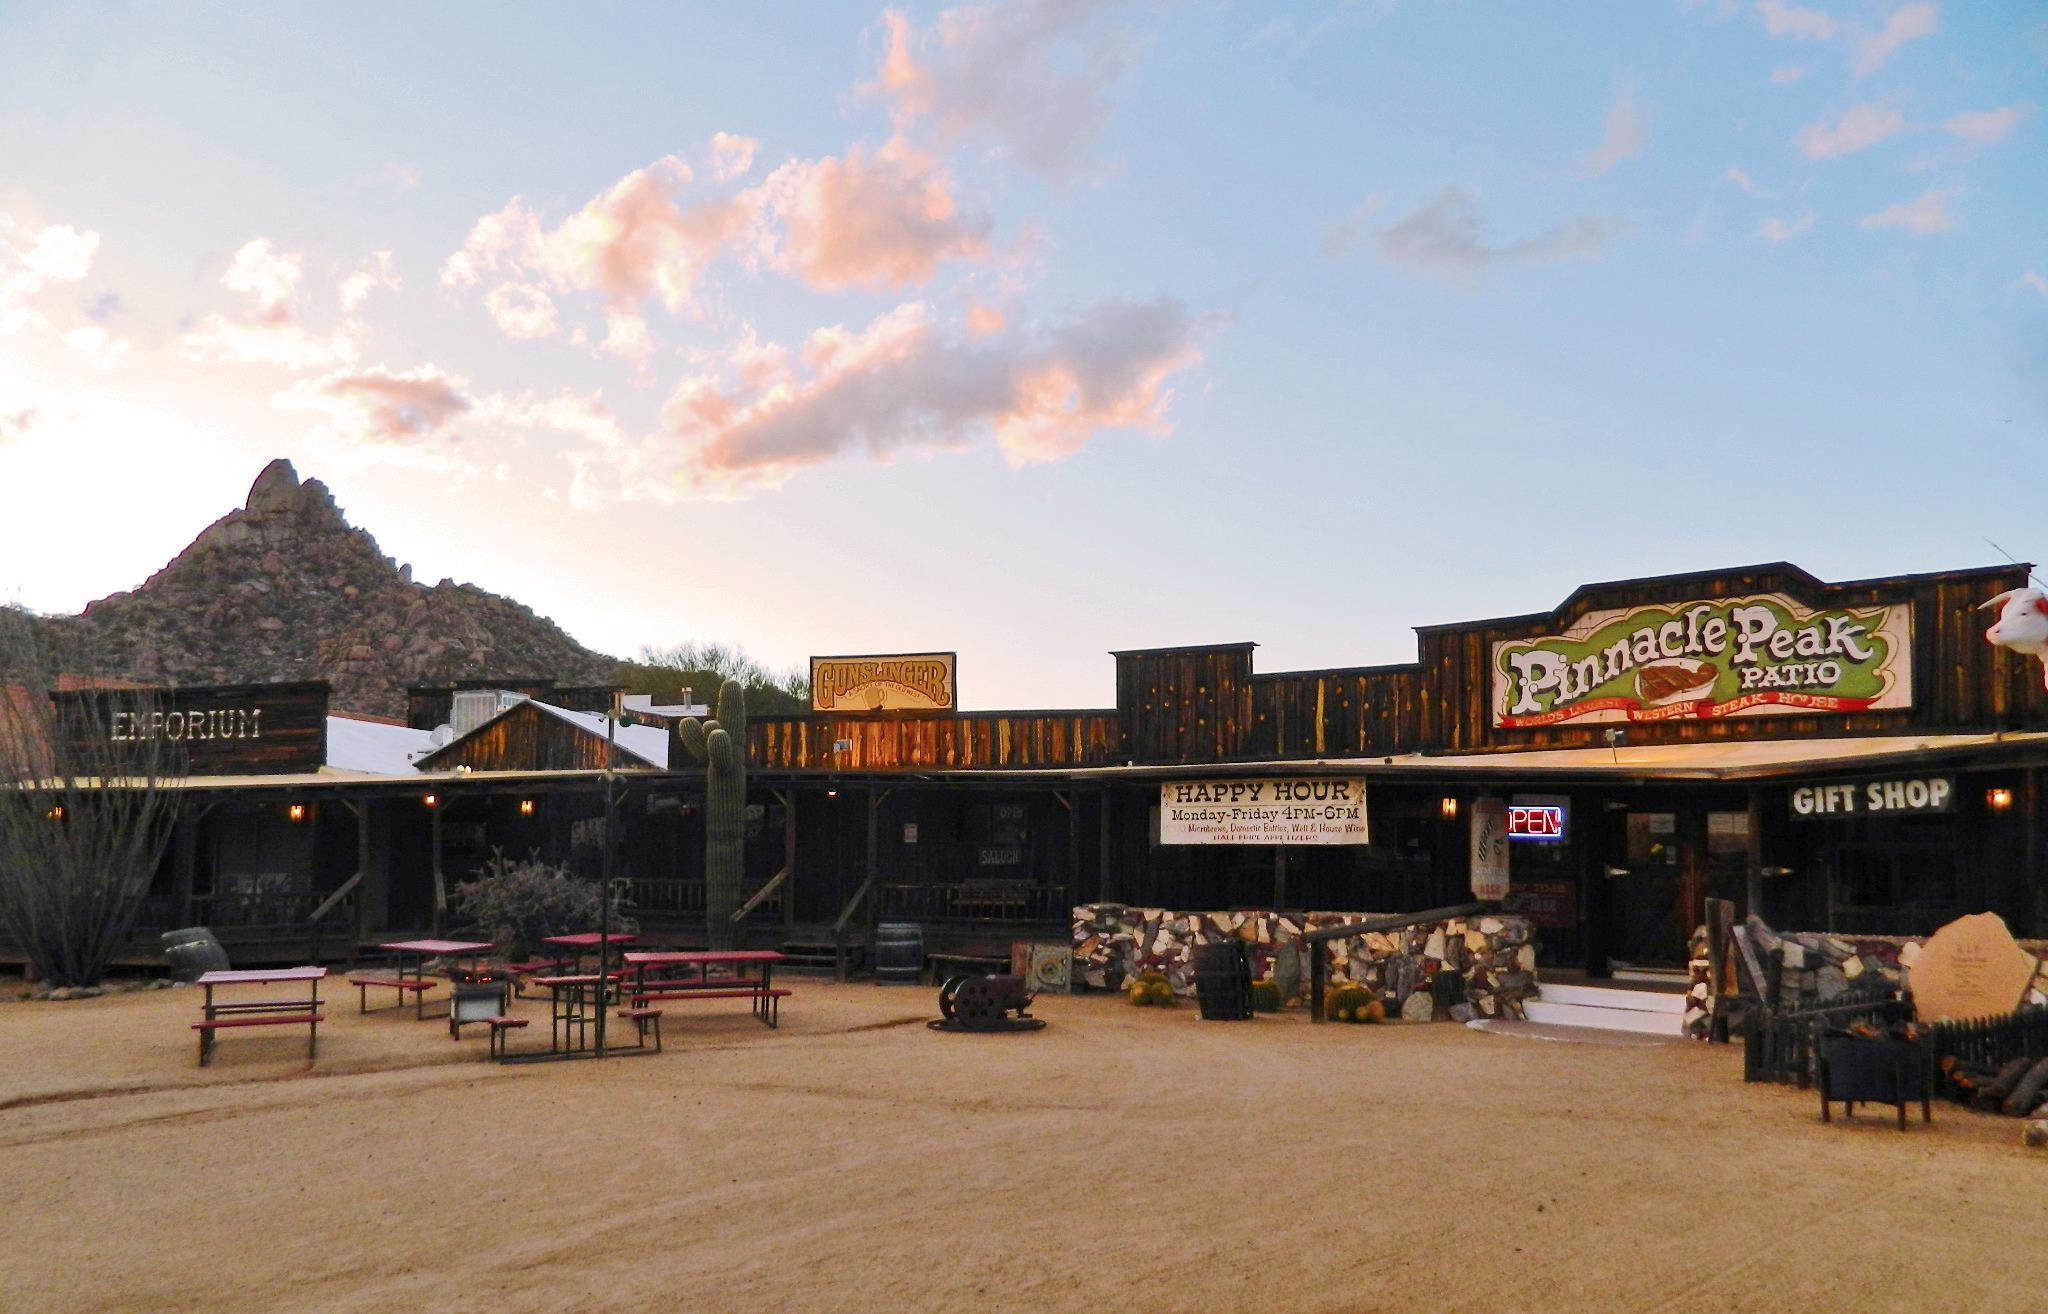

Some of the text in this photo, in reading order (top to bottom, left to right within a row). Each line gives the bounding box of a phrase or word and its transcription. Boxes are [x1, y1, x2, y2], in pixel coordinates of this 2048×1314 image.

[1510, 605, 1874, 715] Pinnacle Peak
[1741, 661, 1842, 689] PATIO
[817, 660, 950, 709] GUNSLINGER
[1632, 701, 1694, 721] WESTERN
[1712, 693, 1767, 716] STEAK
[1778, 692, 1839, 709] HOUSE
[110, 708, 262, 741] EMPORIUM
[1175, 780, 1350, 803] HAPPY HOUR
[1793, 777, 1950, 815] GIFT SHOP
[1171, 804, 1360, 823] Monday-Friday 4PM-6PM
